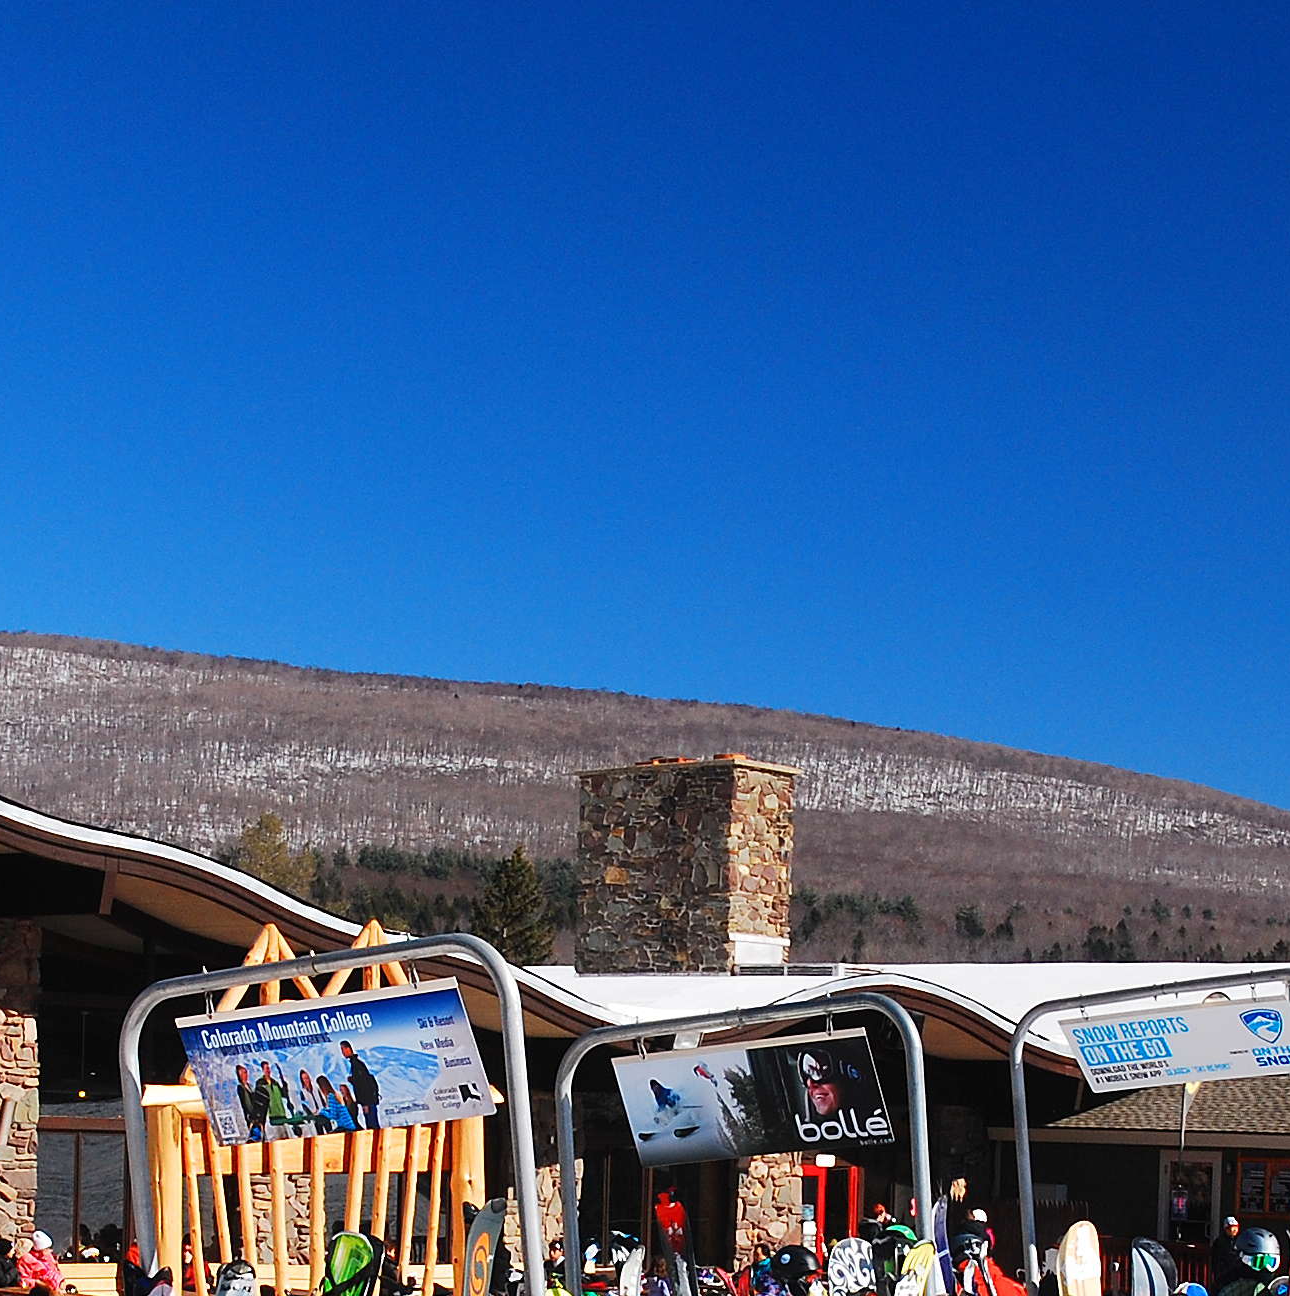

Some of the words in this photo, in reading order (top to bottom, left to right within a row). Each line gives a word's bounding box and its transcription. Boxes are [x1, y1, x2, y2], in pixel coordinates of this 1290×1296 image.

[433, 1015, 455, 1027] Resort
[200, 1024, 258, 1050] Colorado
[258, 1015, 321, 1042] Mountain
[320, 1011, 372, 1033] College
[1072, 1024, 1118, 1045] SNOW
[1118, 1016, 1190, 1040] REPORTS
[434, 1037, 455, 1049] Media
[1084, 1045, 1109, 1065] ON
[1108, 1041, 1143, 1062] THE
[1141, 1039, 1167, 1058] GO
[1252, 1047, 1271, 1057] ON
[443, 1057, 472, 1068] Business
[1090, 1065, 1127, 1076] DOWNLOAD
[1127, 1063, 1139, 1072] THE
[1141, 1060, 1170, 1070] WORLD'S
[1105, 1073, 1130, 1083] MOBILE
[1130, 1071, 1150, 1081] SNOW
[795, 1109, 892, 1143] bollé
